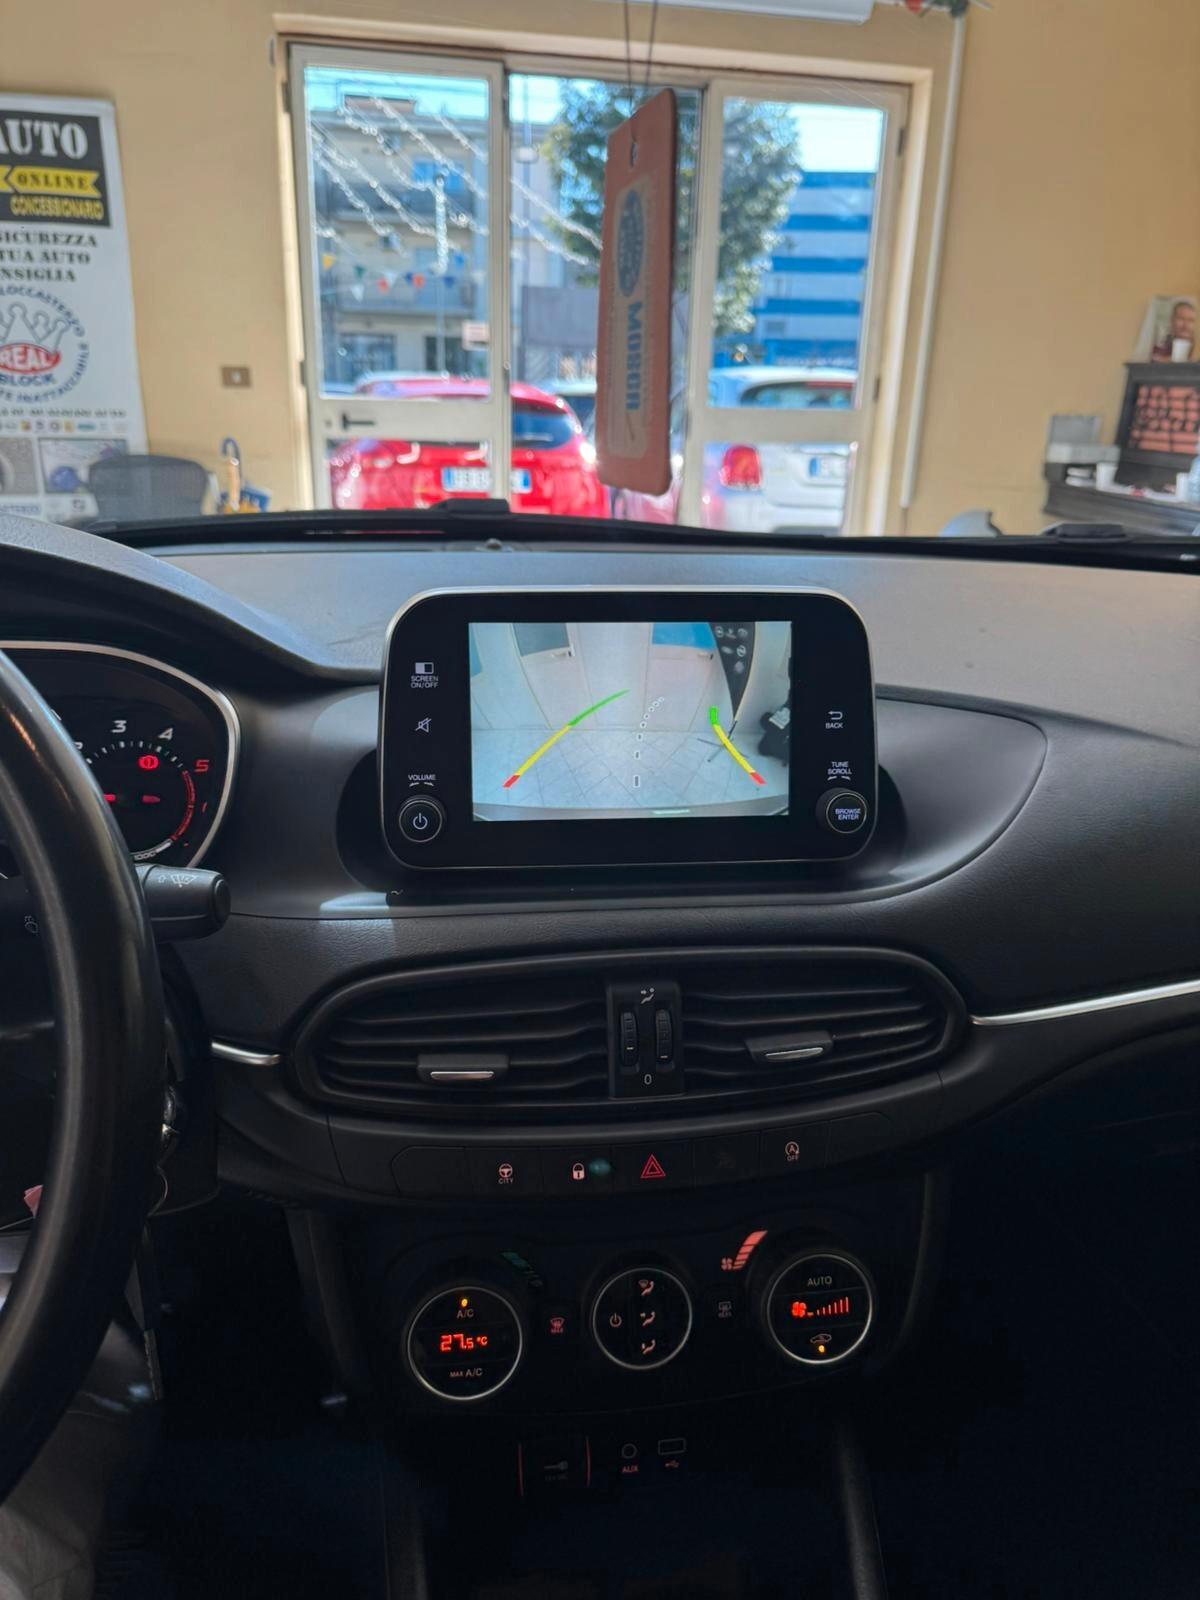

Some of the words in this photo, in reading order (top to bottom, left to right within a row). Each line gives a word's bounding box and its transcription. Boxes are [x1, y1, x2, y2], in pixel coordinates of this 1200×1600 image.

[17, 172, 89, 190] ONLINE
[0, 231, 97, 247] ICUREZZA
[41, 251, 91, 264] AUTO
[112, 719, 127, 733] 3
[158, 727, 174, 740] 4
[194, 759, 210, 773] 5
[835, 807, 861, 815] BROWSE
[644, 1073, 653, 1085] 0
[807, 1275, 832, 1287] AUTO
[456, 1308, 474, 1319] A/C
[449, 1370, 464, 1378] MAX
[465, 1367, 483, 1378] A/C
